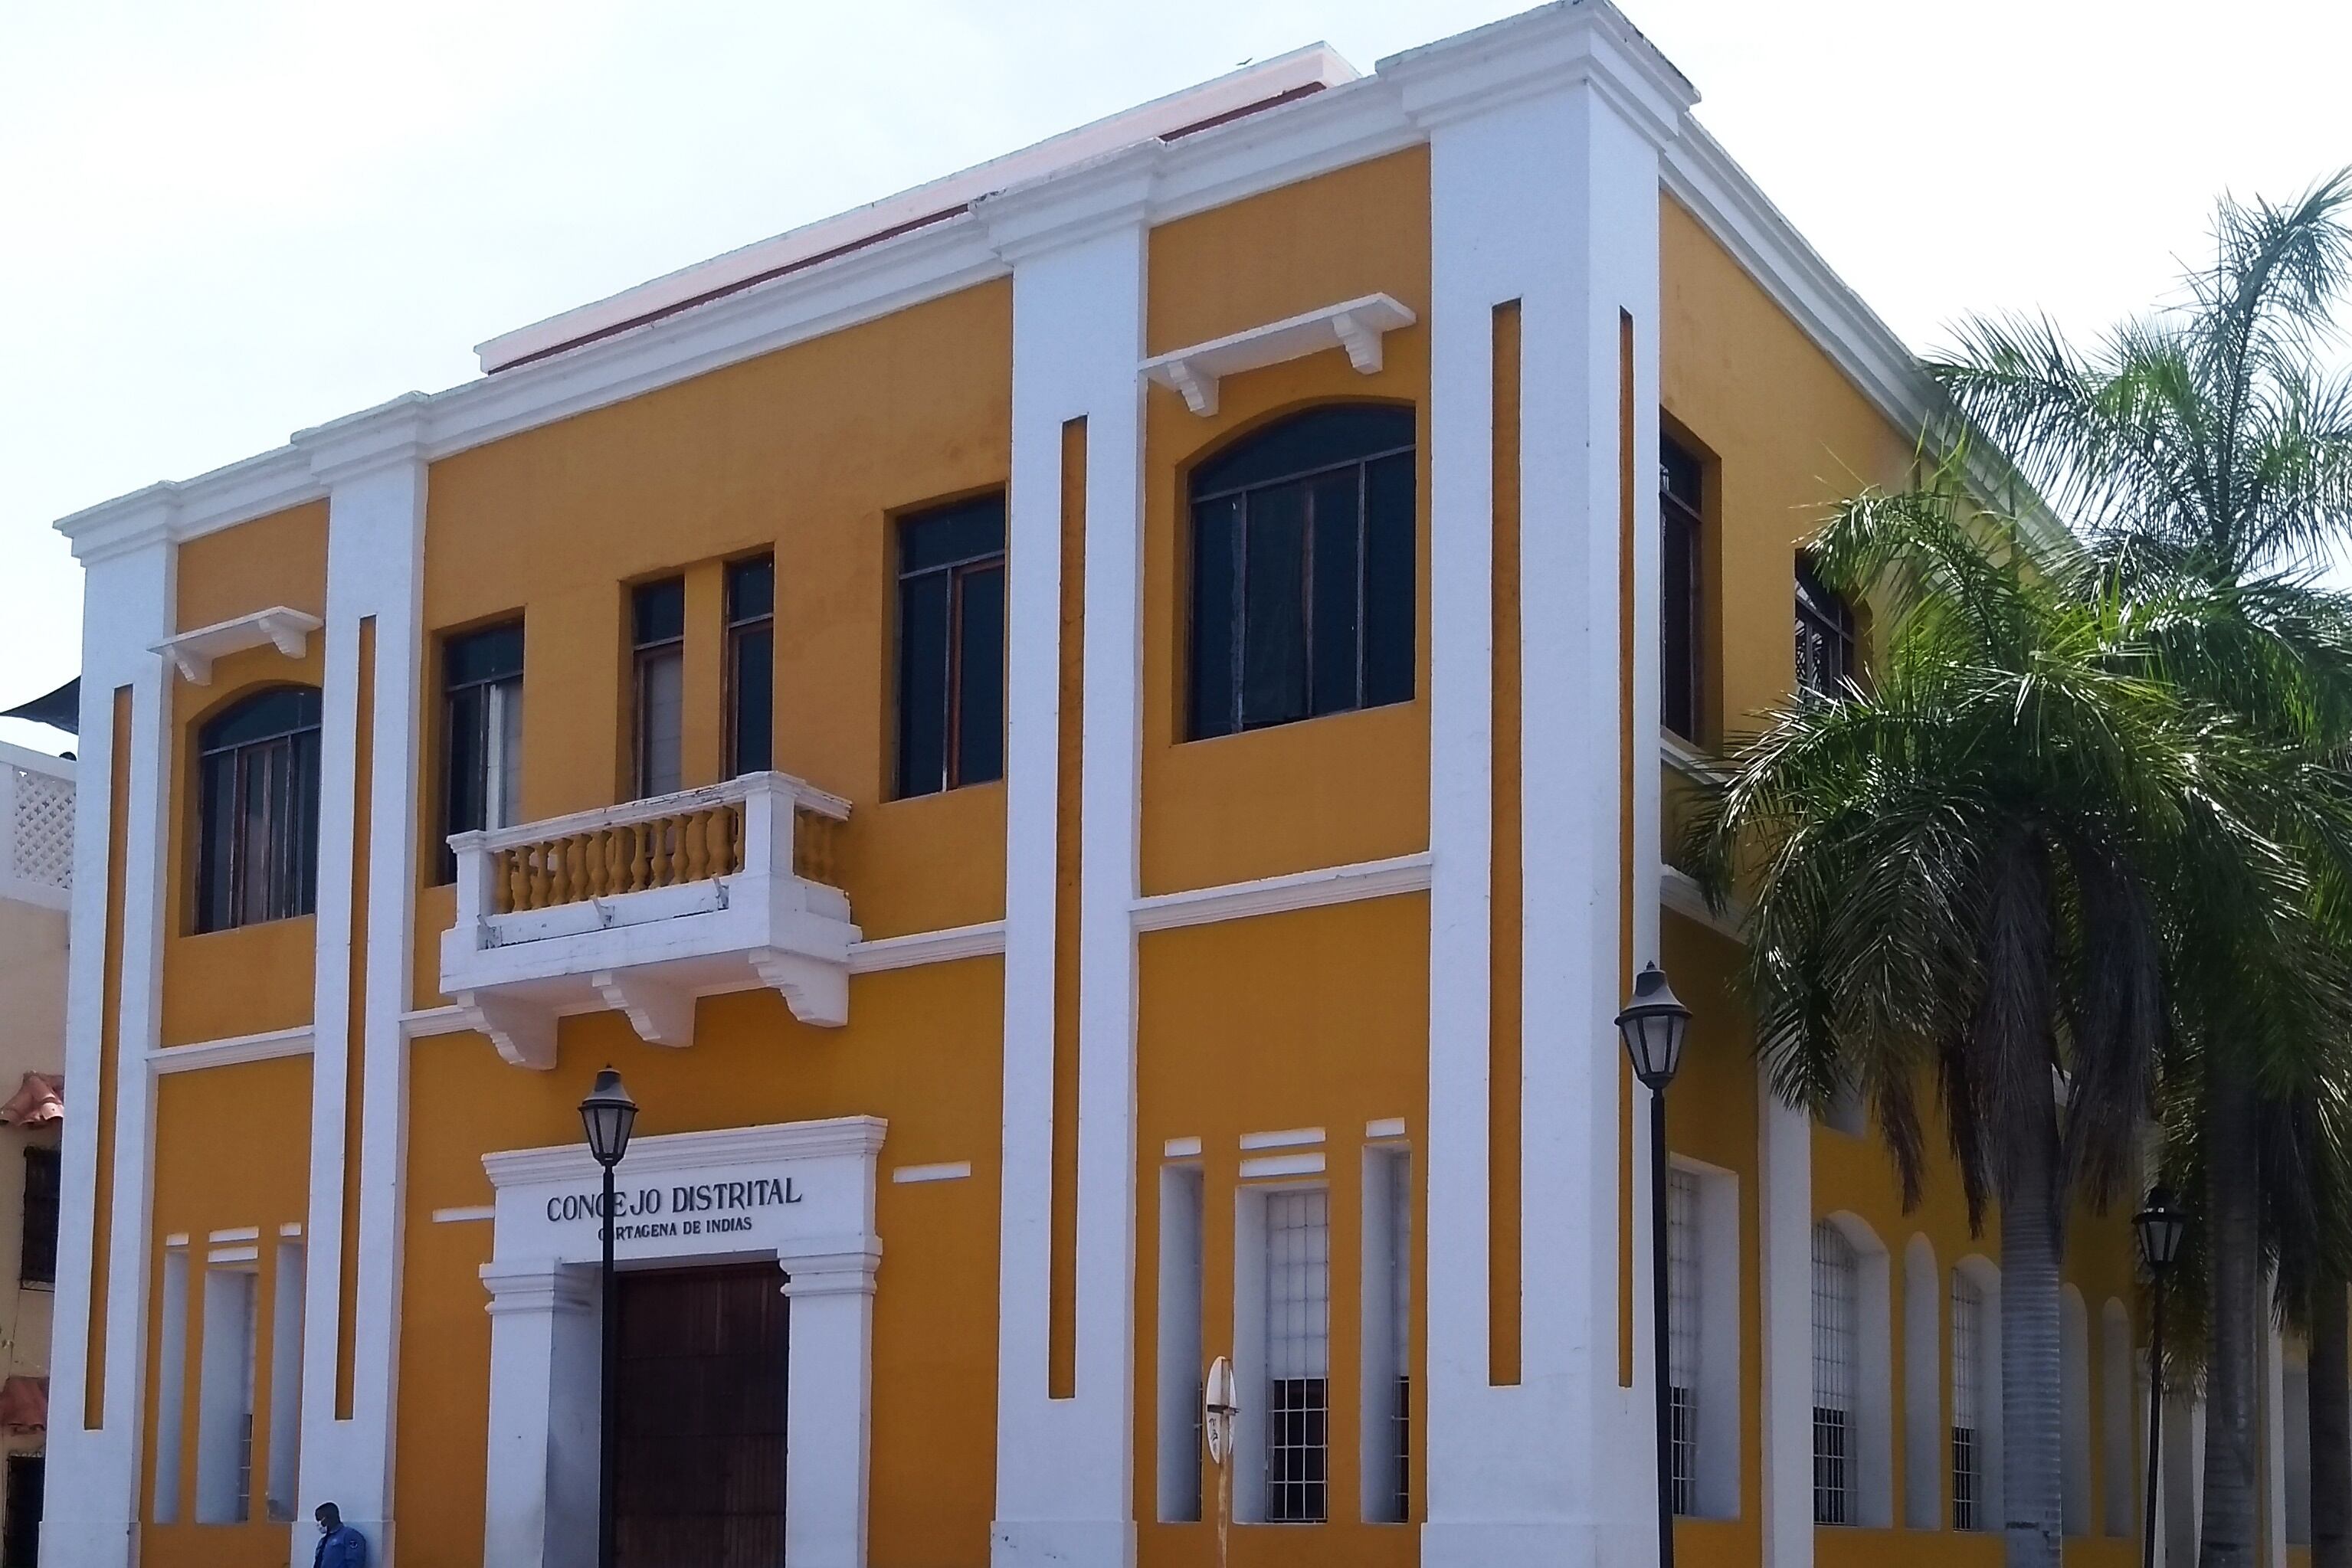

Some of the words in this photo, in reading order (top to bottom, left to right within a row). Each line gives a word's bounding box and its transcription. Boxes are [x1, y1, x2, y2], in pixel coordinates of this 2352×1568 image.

[672, 1177, 803, 1213] DISTRITAL
[598, 1222, 677, 1241] CRTAGENA
[683, 1220, 701, 1235] DE
[706, 1216, 752, 1233] INDIAS
